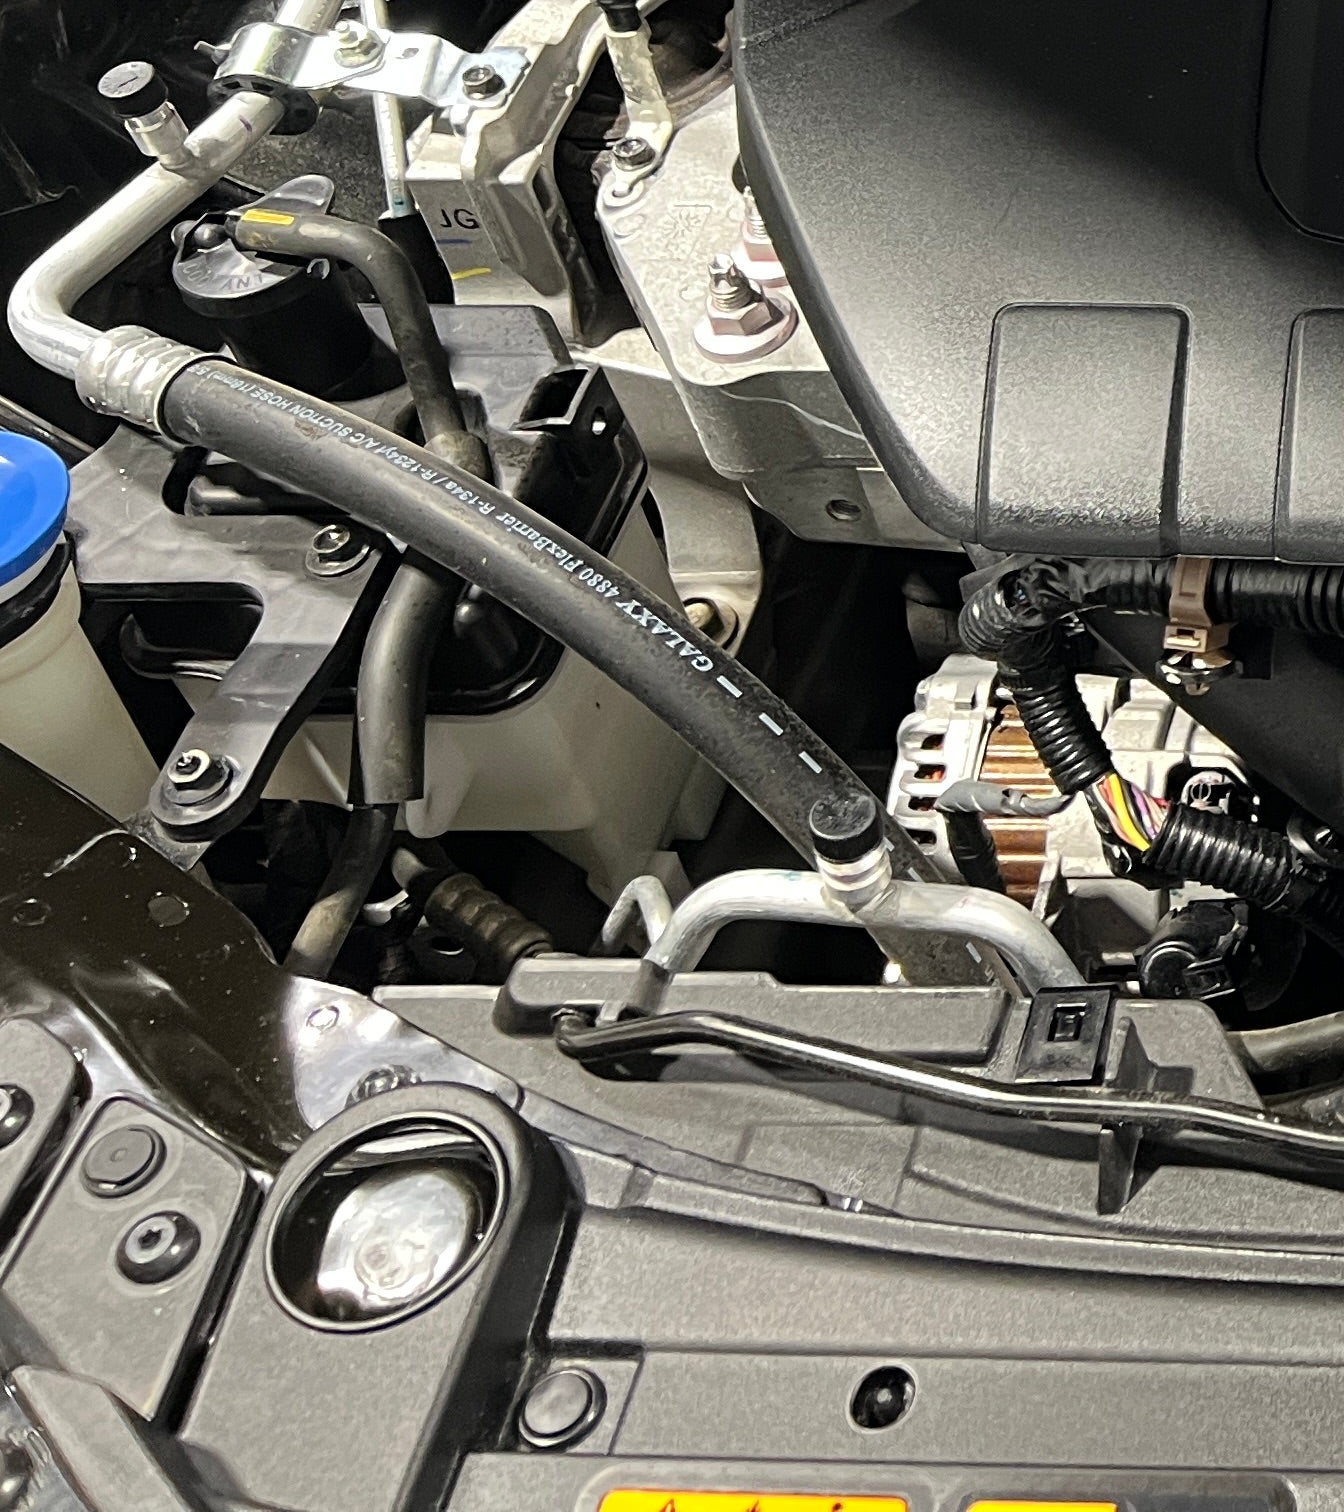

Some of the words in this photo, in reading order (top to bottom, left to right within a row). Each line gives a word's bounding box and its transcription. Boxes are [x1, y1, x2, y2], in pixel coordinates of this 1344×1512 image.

[440, 208, 481, 230] JG
[250, 388, 293, 411] HOSE
[289, 405, 353, 437] SUCTION
[349, 432, 381, 449] A/C
[445, 480, 496, 515] R-134a
[495, 512, 585, 573] FlexBarrier
[615, 599, 714, 672] GALAXY
